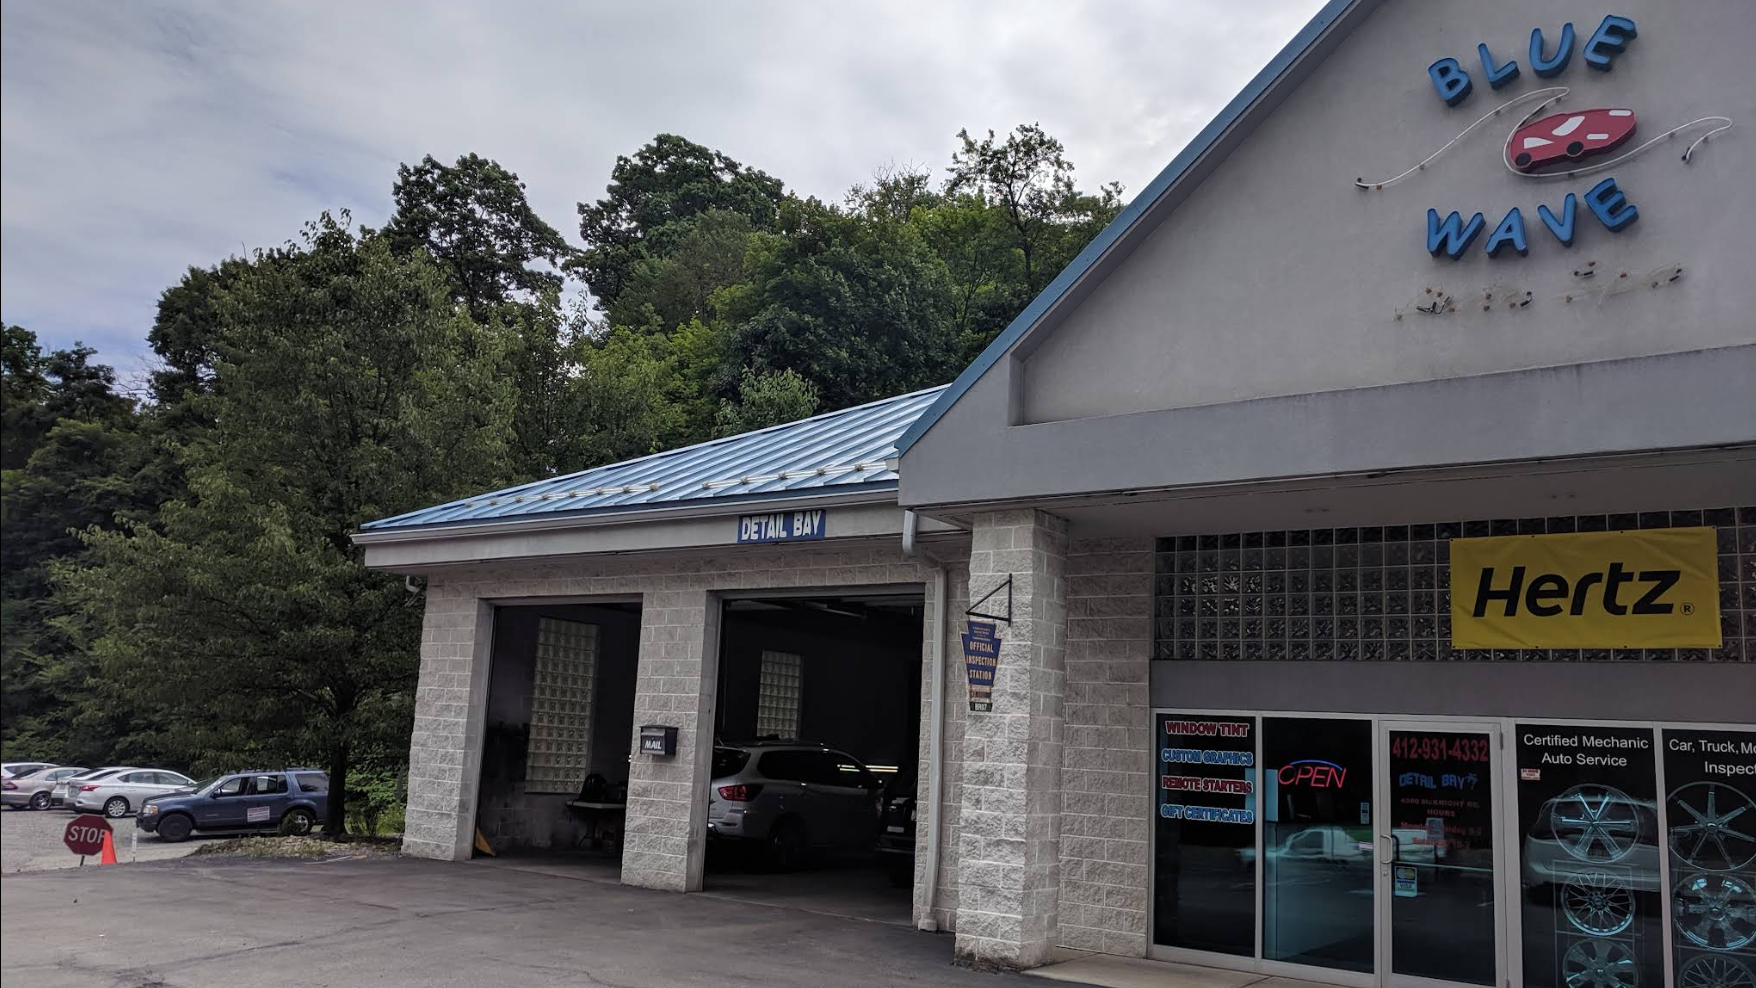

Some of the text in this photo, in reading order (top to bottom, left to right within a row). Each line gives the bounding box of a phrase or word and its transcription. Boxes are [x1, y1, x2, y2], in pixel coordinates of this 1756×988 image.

[1428, 15, 1637, 107] BLUE
[1427, 177, 1639, 260] WAVE
[741, 510, 822, 541] DETAIL BAY
[1473, 562, 1681, 618] Hertz
[969, 641, 994, 653] OFFICIAL
[966, 655, 997, 667] INSPECTION
[969, 669, 992, 681] STATION
[1165, 720, 1250, 738] WINDOW TINT
[644, 739, 662, 750] MAIL
[1392, 737, 1488, 762] 412-931-4332
[1523, 734, 1649, 749] Certified Mechanic
[1669, 738, 1695, 753] Car,
[1698, 739, 1739, 755] Truck,
[1161, 748, 1253, 767] CUSTOM GRAPHICS
[1541, 753, 1627, 767] Auto Service
[1161, 775, 1253, 795] REMOTE STARTERS
[1278, 765, 1346, 789] OPEN
[1399, 772, 1465, 790] DETAIL BAY
[1160, 804, 1254, 825] GIFT CERTIFICATES
[1426, 808, 1456, 817] HOURS
